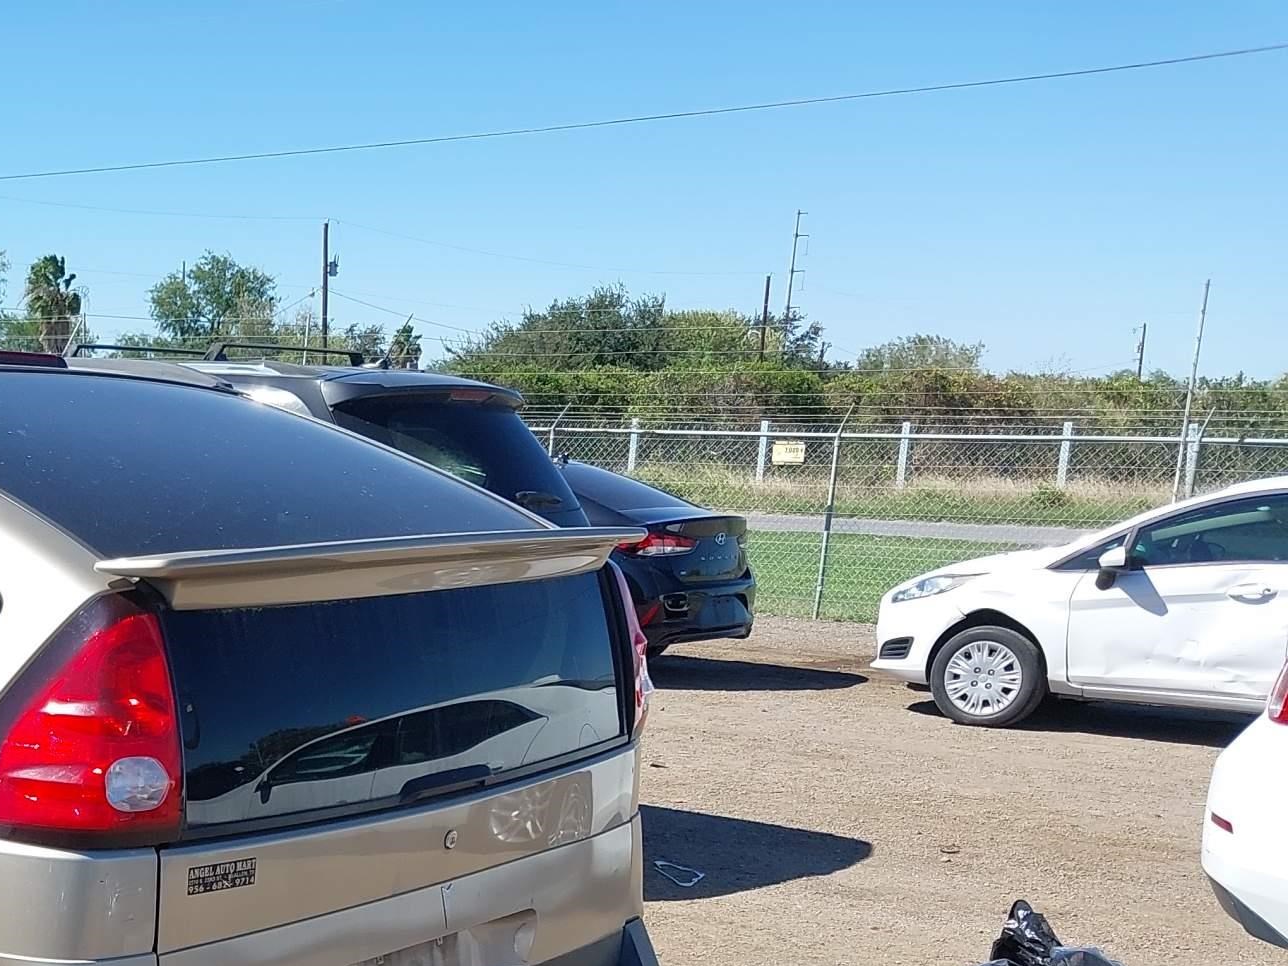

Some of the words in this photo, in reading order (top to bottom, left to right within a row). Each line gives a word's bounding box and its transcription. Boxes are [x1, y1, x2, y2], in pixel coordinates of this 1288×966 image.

[189, 866, 214, 879] ANGEL
[215, 863, 235, 875] AUTO
[236, 859, 255, 871] MART
